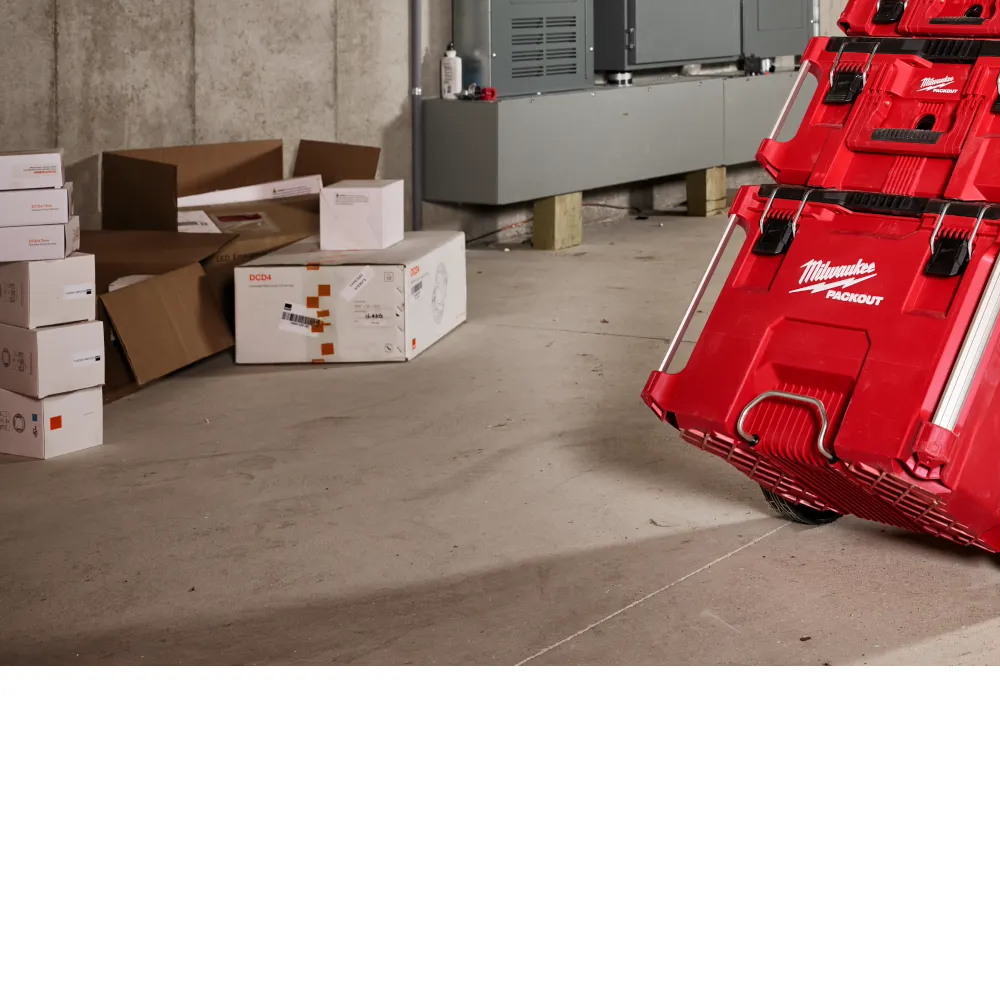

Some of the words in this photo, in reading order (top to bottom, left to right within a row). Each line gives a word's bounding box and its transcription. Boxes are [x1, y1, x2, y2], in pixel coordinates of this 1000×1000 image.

[919, 75, 955, 88] Milwaukee
[798, 258, 876, 285] Milwaukee
[825, 289, 885, 307] PACKOUT
